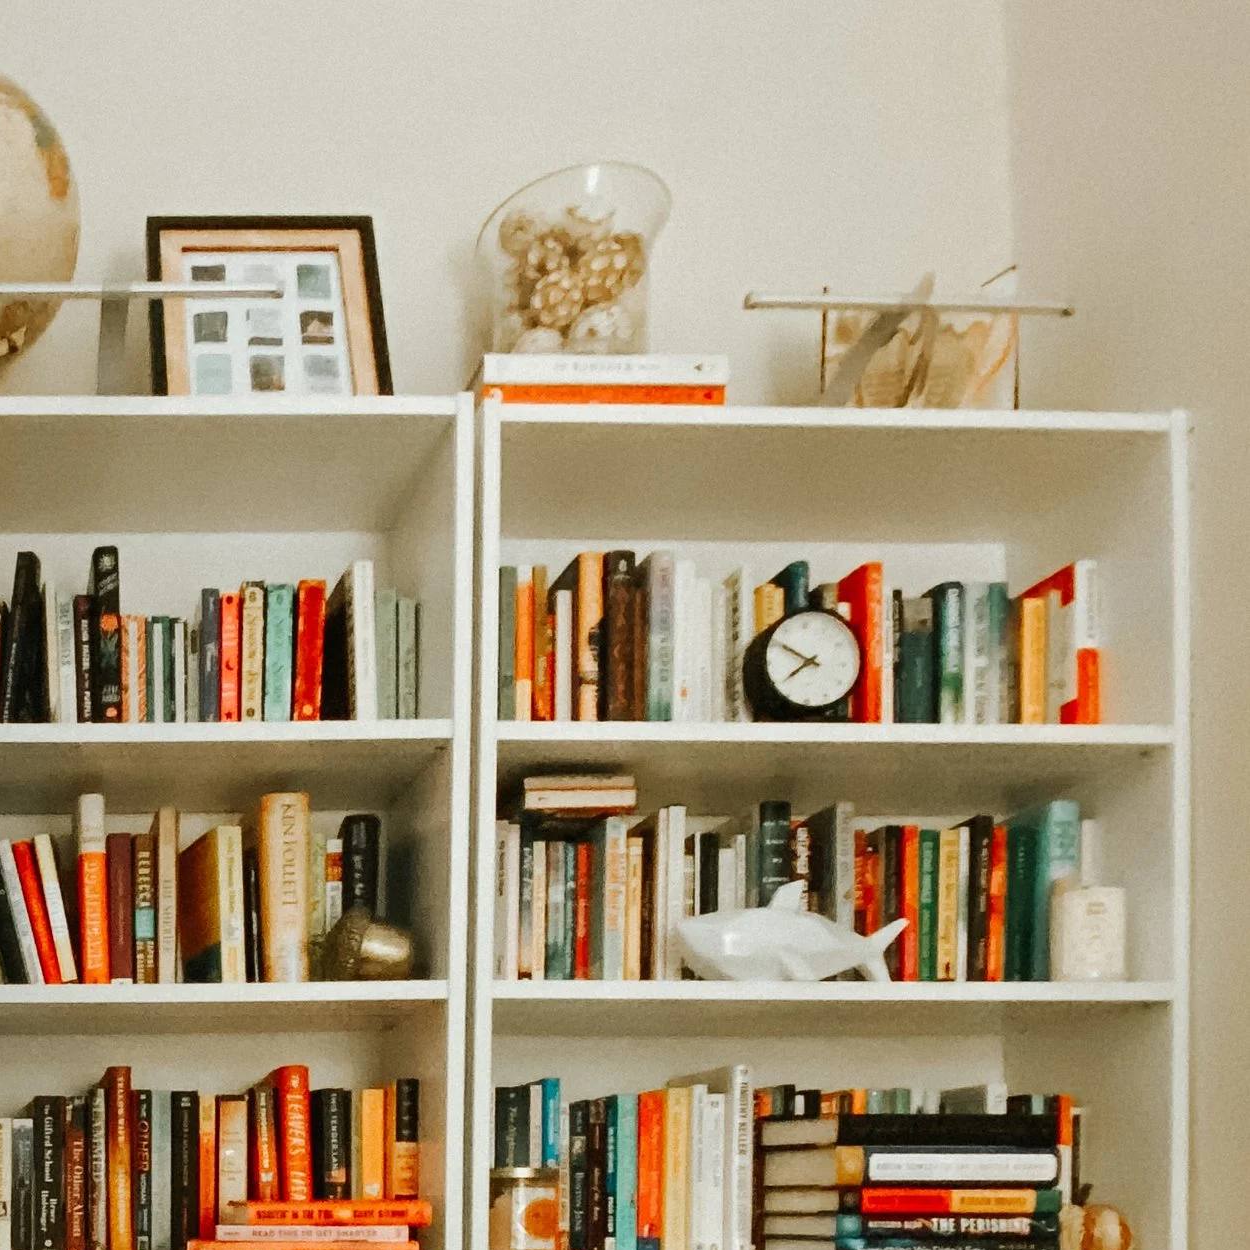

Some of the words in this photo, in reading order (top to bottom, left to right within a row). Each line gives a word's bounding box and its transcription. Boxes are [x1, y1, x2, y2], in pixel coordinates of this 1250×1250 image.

[281, 803, 298, 836] KEN
[137, 851, 148, 907] REBECCA
[281, 839, 298, 907] FOLLETT
[44, 1116, 53, 1147] Gifted
[287, 1094, 306, 1155] LEAVERS
[72, 1139, 84, 1161] The
[137, 1120, 149, 1171] OTHER
[44, 1149, 53, 1182] School
[72, 1165, 84, 1198] Other
[72, 1202, 84, 1237] Alcott
[931, 1217, 956, 1232] THE
